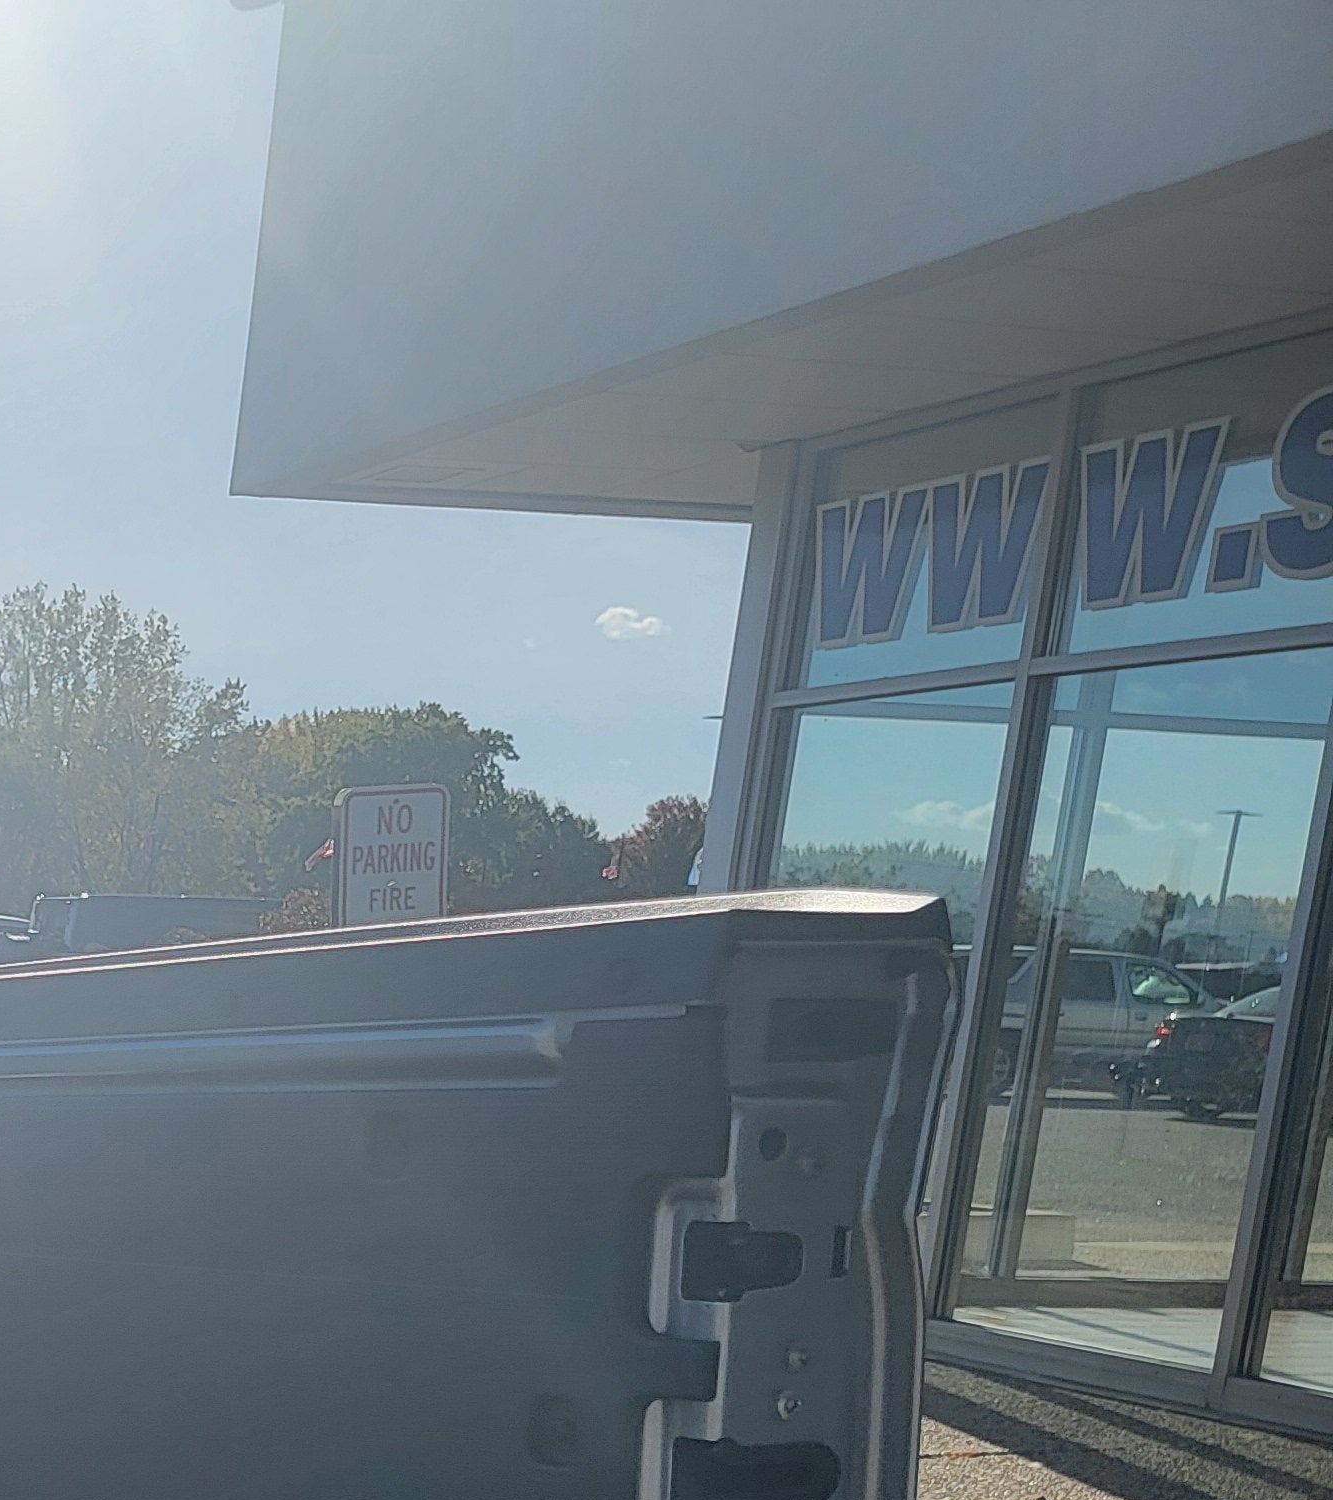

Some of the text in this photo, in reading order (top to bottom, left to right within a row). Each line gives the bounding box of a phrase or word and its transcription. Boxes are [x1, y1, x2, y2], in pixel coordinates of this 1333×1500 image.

[376, 803, 414, 835] NO
[352, 841, 436, 875] PARKING
[369, 886, 417, 912] FIRE
